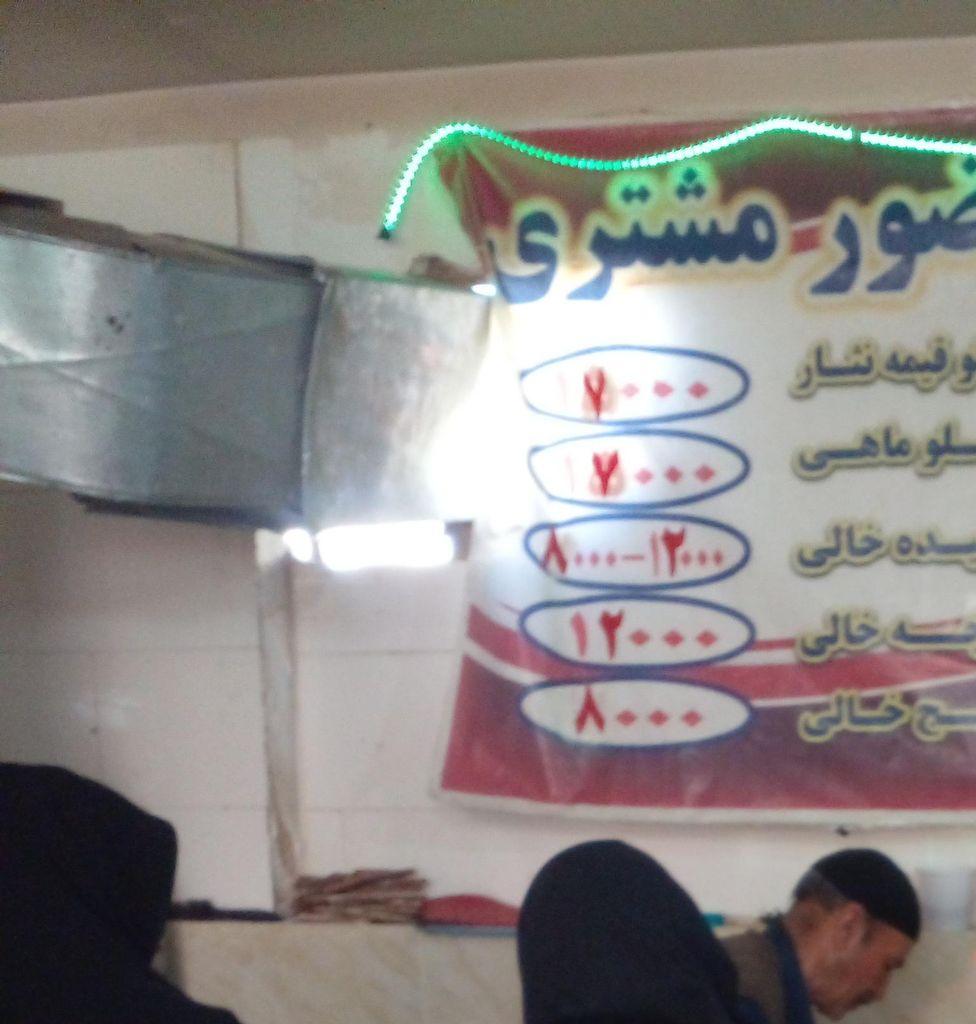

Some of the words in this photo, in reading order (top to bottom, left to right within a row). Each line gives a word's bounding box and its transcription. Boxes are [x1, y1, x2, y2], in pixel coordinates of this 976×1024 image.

[494, 165, 779, 304] مشتری
[882, 335, 951, 387] قیمه
[796, 424, 913, 474] ماهی
[796, 519, 886, 571] خالی
[570, 608, 719, 662] ۱۲۰۰۰
[798, 609, 881, 660] خالی
[574, 683, 703, 735] ۸۰۰۰
[799, 688, 908, 740] خالی
